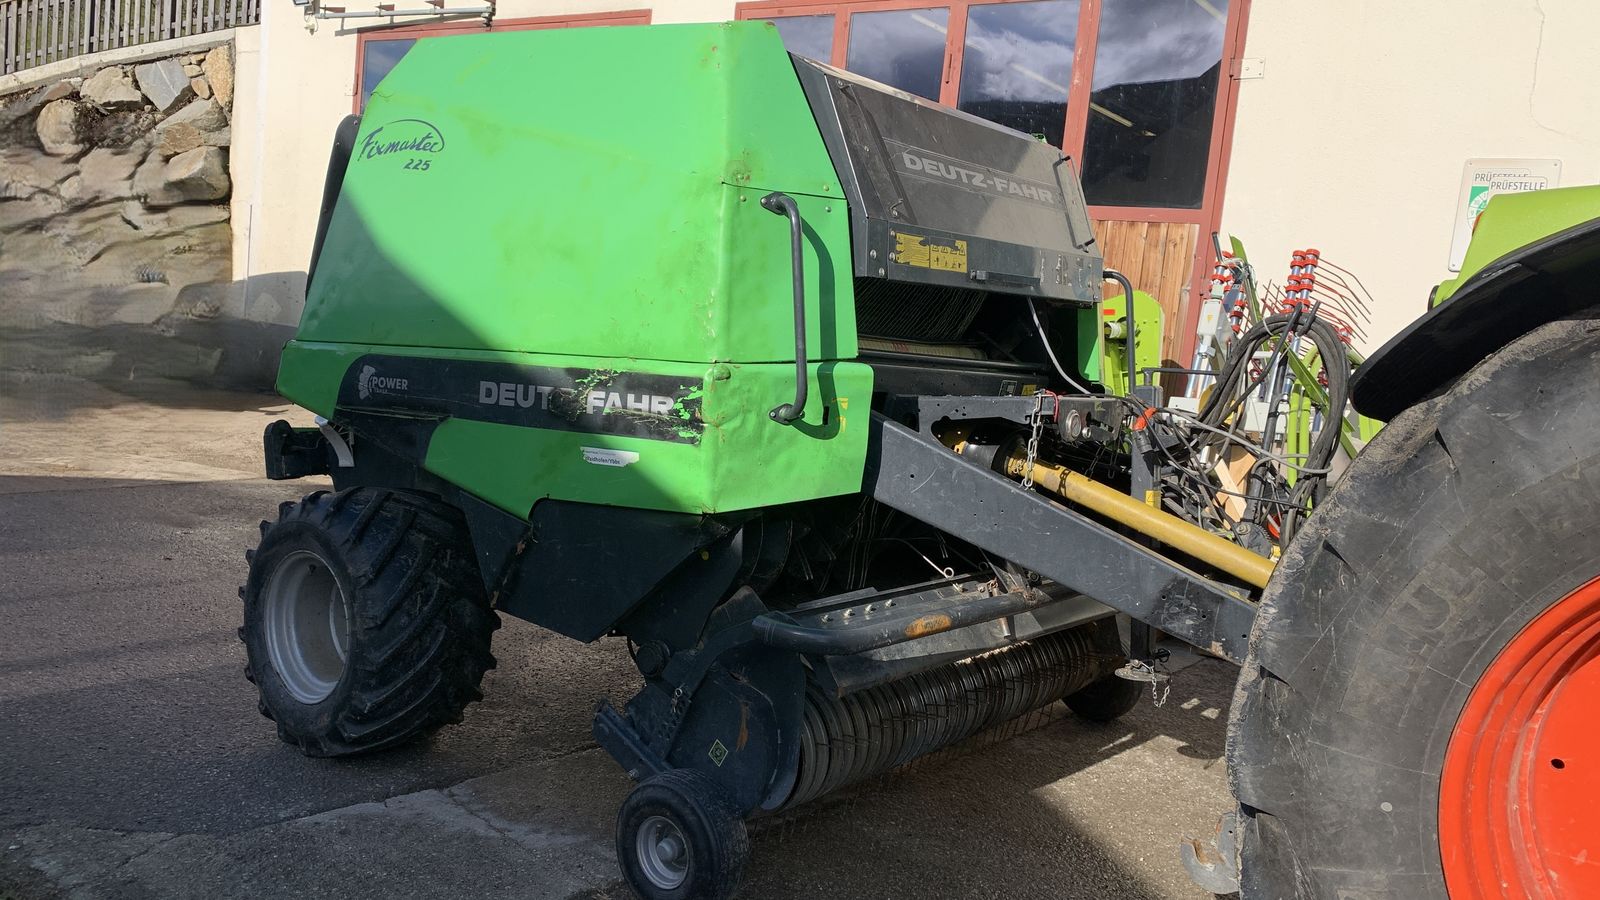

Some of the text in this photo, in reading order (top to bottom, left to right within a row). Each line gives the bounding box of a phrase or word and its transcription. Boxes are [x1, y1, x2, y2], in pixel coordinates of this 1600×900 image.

[403, 158, 432, 171] 225
[902, 151, 1055, 204] DEUTZ-FAHR
[1490, 180, 1546, 191] PRÜFSTELLE
[372, 376, 409, 390] POWER
